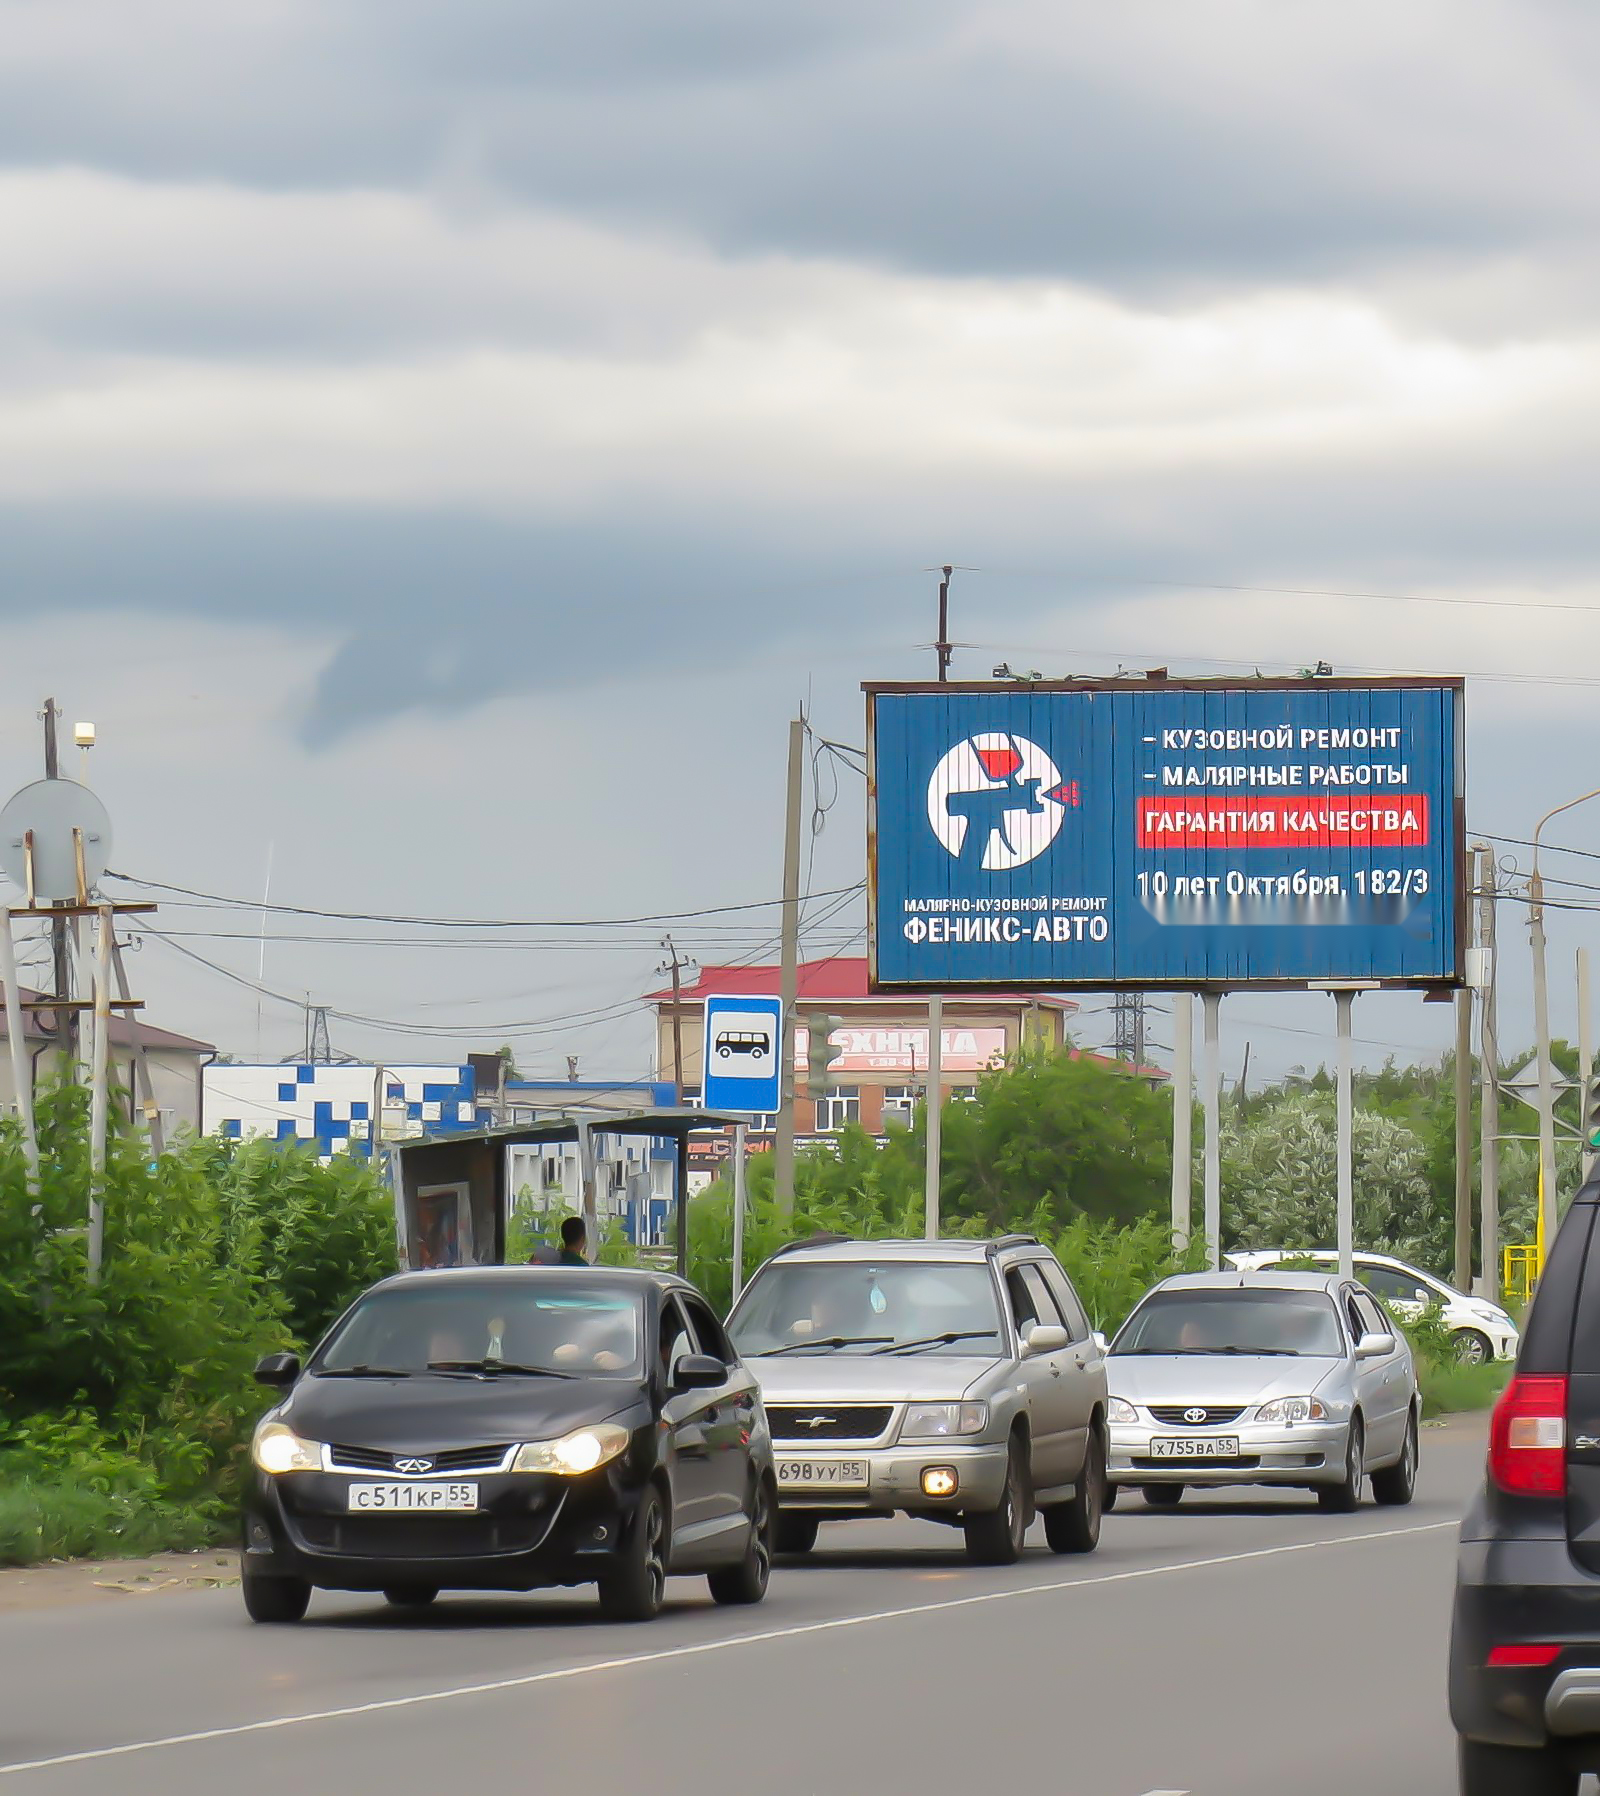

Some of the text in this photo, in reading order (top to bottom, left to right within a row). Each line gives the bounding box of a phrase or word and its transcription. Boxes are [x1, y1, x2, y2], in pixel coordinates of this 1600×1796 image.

[1162, 724, 1294, 750] КУЗОВНОЙ
[1300, 727, 1401, 749] РЕМОНТ
[1162, 765, 1303, 786] МАЛЯРНЫЕ
[1309, 764, 1408, 786] РАБОТЫ
[1145, 809, 1419, 832] ГАРАНТИЯ КАЧЕСТВА
[1137, 870, 1168, 896] 10
[1174, 875, 1221, 896] лет
[1354, 868, 1429, 896] 182/3
[904, 895, 1108, 912] МАЛЯРНО-КУЗОВНОЙ РЕМОНТ
[903, 915, 1109, 944] ФЕНИКС-АВТО
[1218, 1440, 1233, 1451] 55
[842, 1462, 860, 1476] 55
[357, 1486, 470, 1507] С511КР 55
